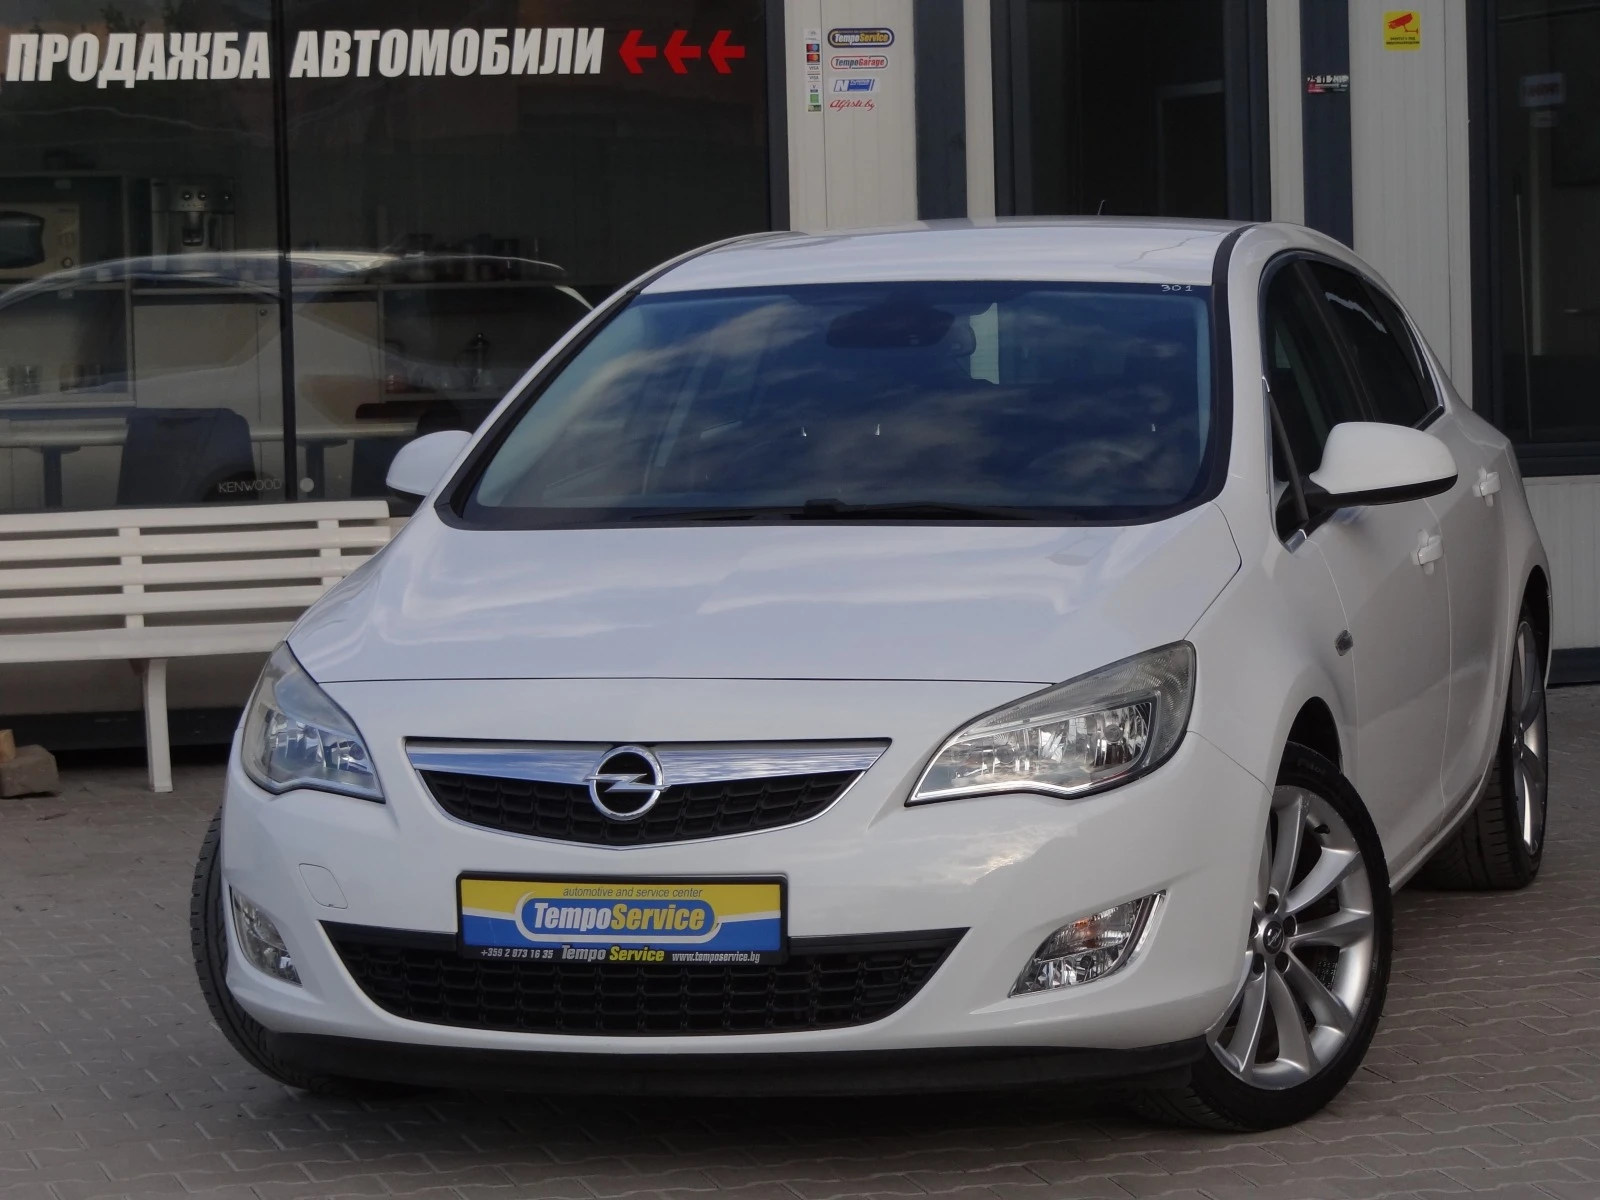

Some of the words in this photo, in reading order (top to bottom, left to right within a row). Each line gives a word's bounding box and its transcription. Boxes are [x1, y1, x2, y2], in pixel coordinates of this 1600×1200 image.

[5, 31, 271, 89] ПРОДАЖБА
[289, 27, 605, 78] АВТОМОБИЛИ
[835, 58, 885, 69] TempoGarage
[218, 478, 282, 493] KENWOOD
[563, 887, 613, 897] automotive
[616, 887, 634, 897] and
[636, 888, 669, 897] service
[672, 888, 703, 898] center
[534, 902, 705, 931] TempoService
[480, 947, 503, 958] +359
[504, 948, 511, 957] 2
[530, 949, 541, 959] 16
[543, 949, 554, 959] 35
[561, 944, 607, 962] Tempo
[609, 946, 665, 962] Service
[672, 951, 761, 964] www.temposervice.bg
